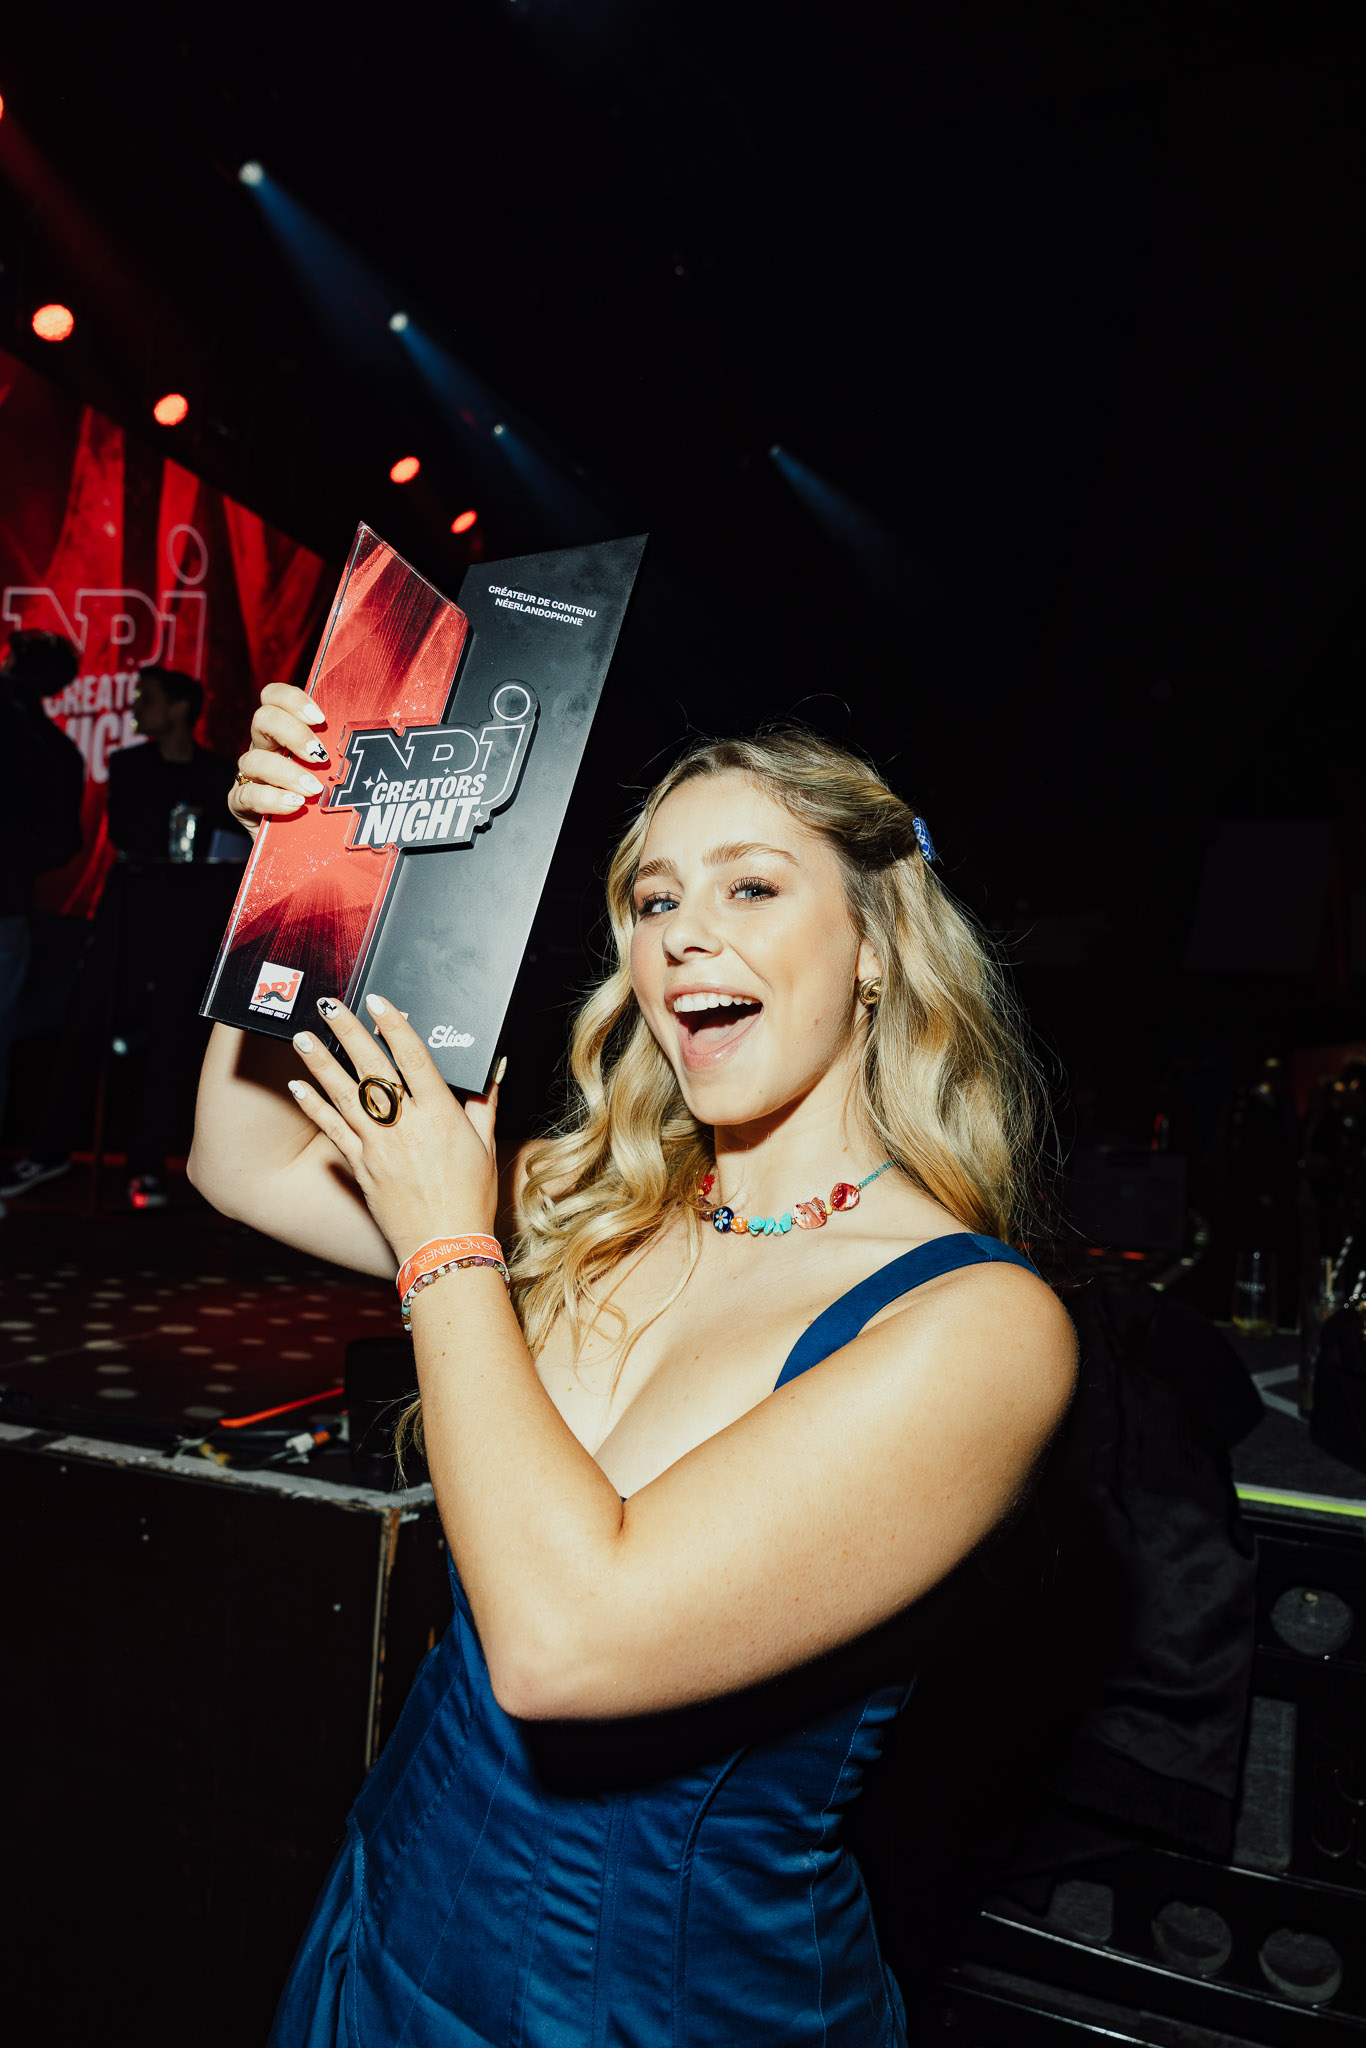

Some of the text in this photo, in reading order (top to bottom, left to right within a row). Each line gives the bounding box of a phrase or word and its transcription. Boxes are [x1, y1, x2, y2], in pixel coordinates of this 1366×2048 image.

[488, 585, 597, 618] CRÉATEUR DE CONTENU
[494, 598, 584, 626] NÉERLANDOPHONE
[371, 773, 487, 804] CREATORS
[357, 796, 482, 845] NIGHT
[418, 1241, 481, 1264] NOMINEE
